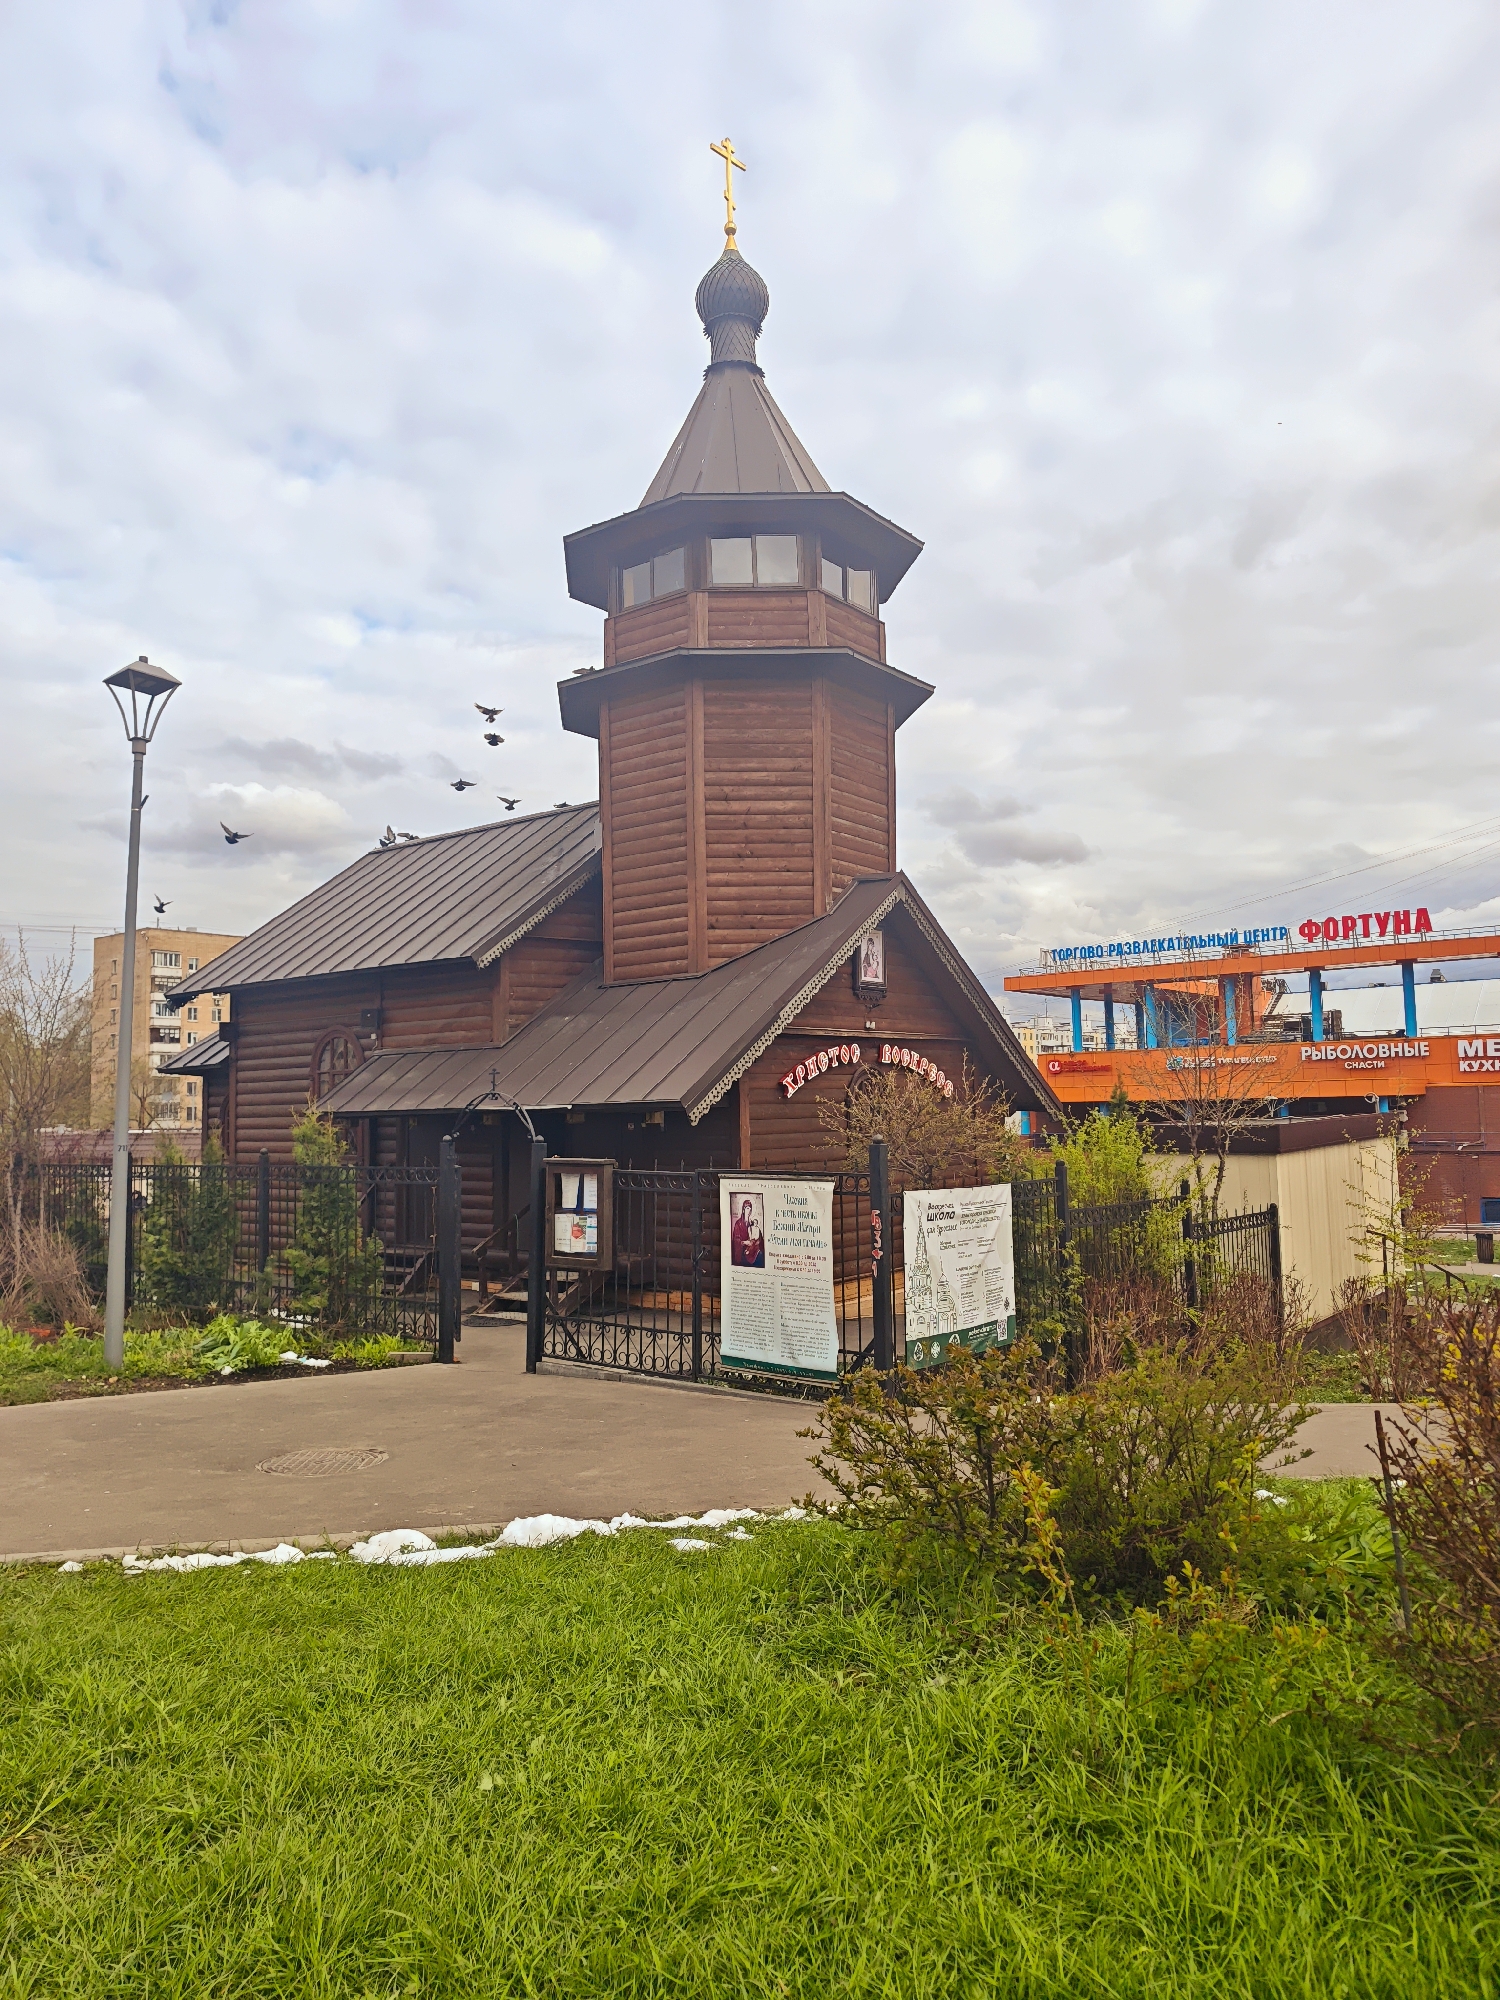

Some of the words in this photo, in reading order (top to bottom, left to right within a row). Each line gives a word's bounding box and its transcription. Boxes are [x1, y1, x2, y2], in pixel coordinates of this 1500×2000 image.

[1298, 907, 1433, 943] ФОРТУНА
[1243, 926, 1288, 945] ЦЕНТР
[1301, 1041, 1430, 1061] РЫБОЛОВНЫЕ
[781, 1043, 861, 1098] ХРИСТОС
[1344, 1060, 1385, 1069] СНАСТИ
